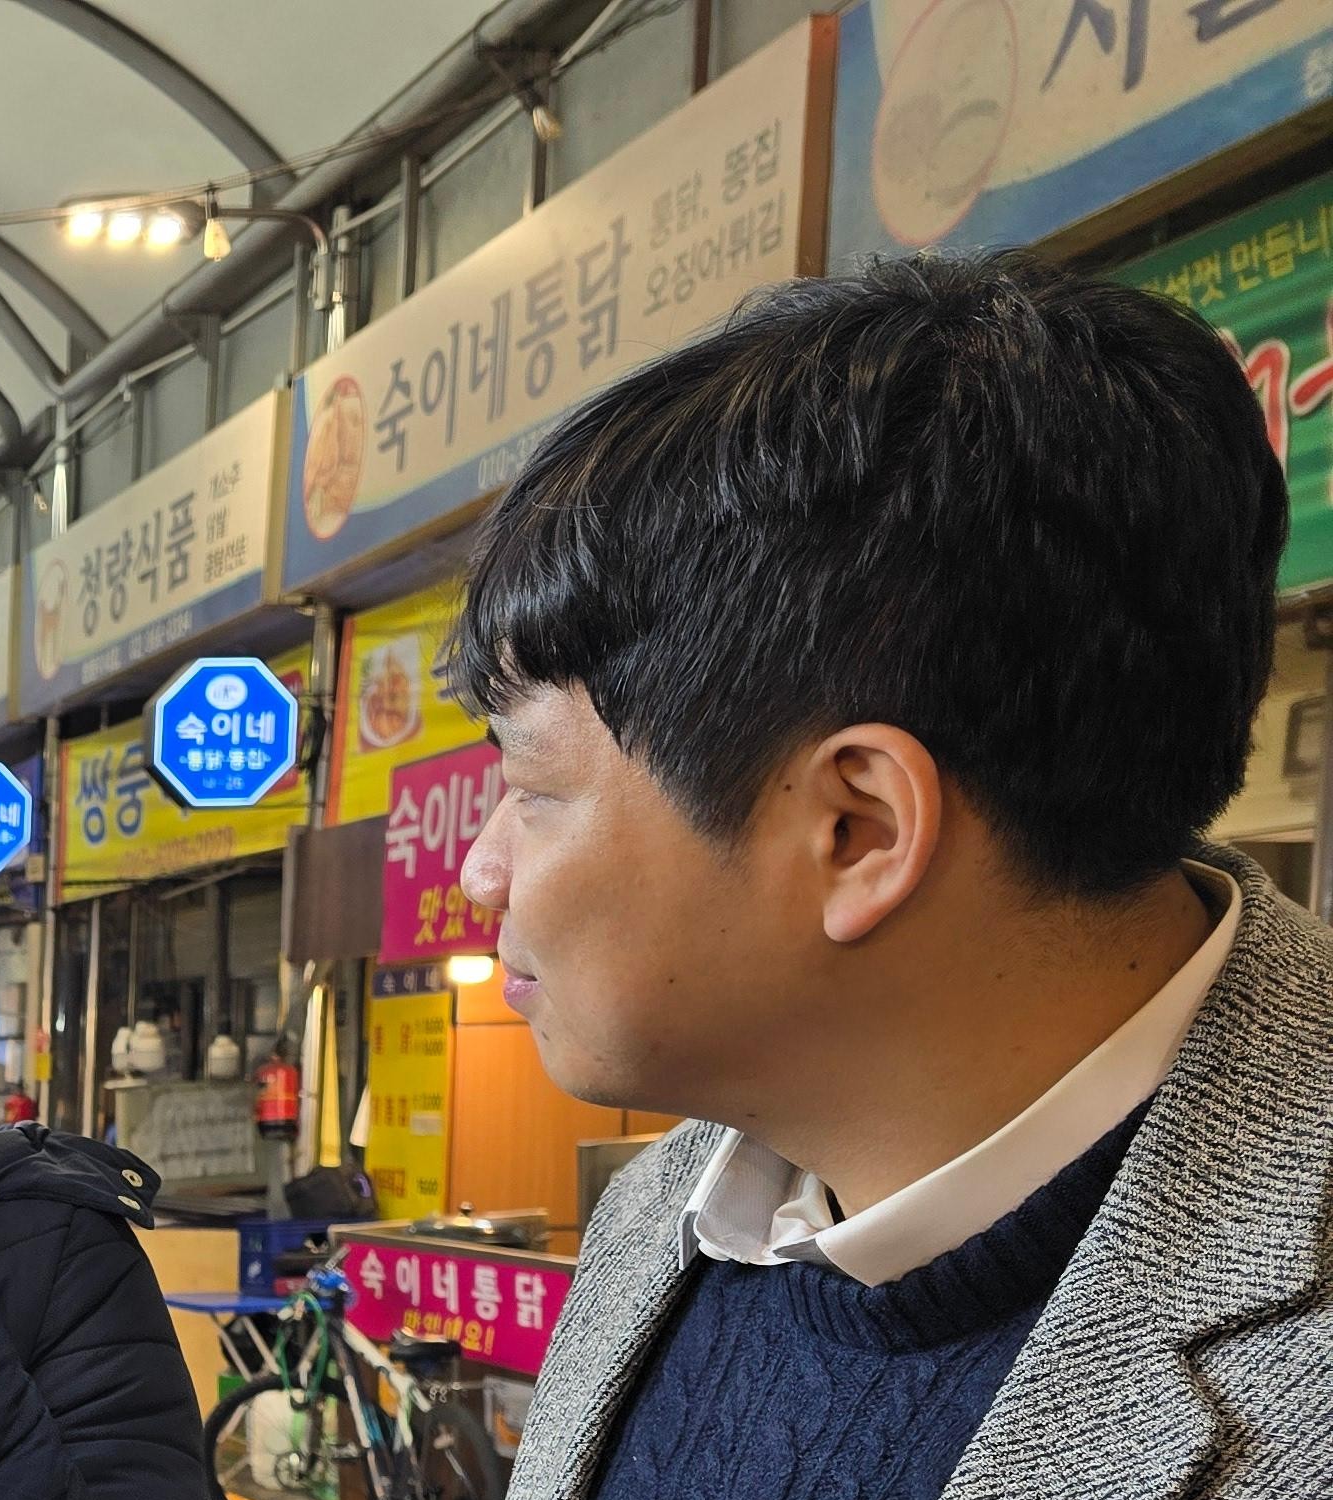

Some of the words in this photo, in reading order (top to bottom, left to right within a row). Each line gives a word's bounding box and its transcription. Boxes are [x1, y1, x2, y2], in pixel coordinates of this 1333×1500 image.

[374, 215, 633, 472] 숙이네통닭
[77, 490, 196, 637] 청량식품
[175, 711, 276, 745] 숙이네
[360, 1249, 547, 1330] 숙이네통닭
